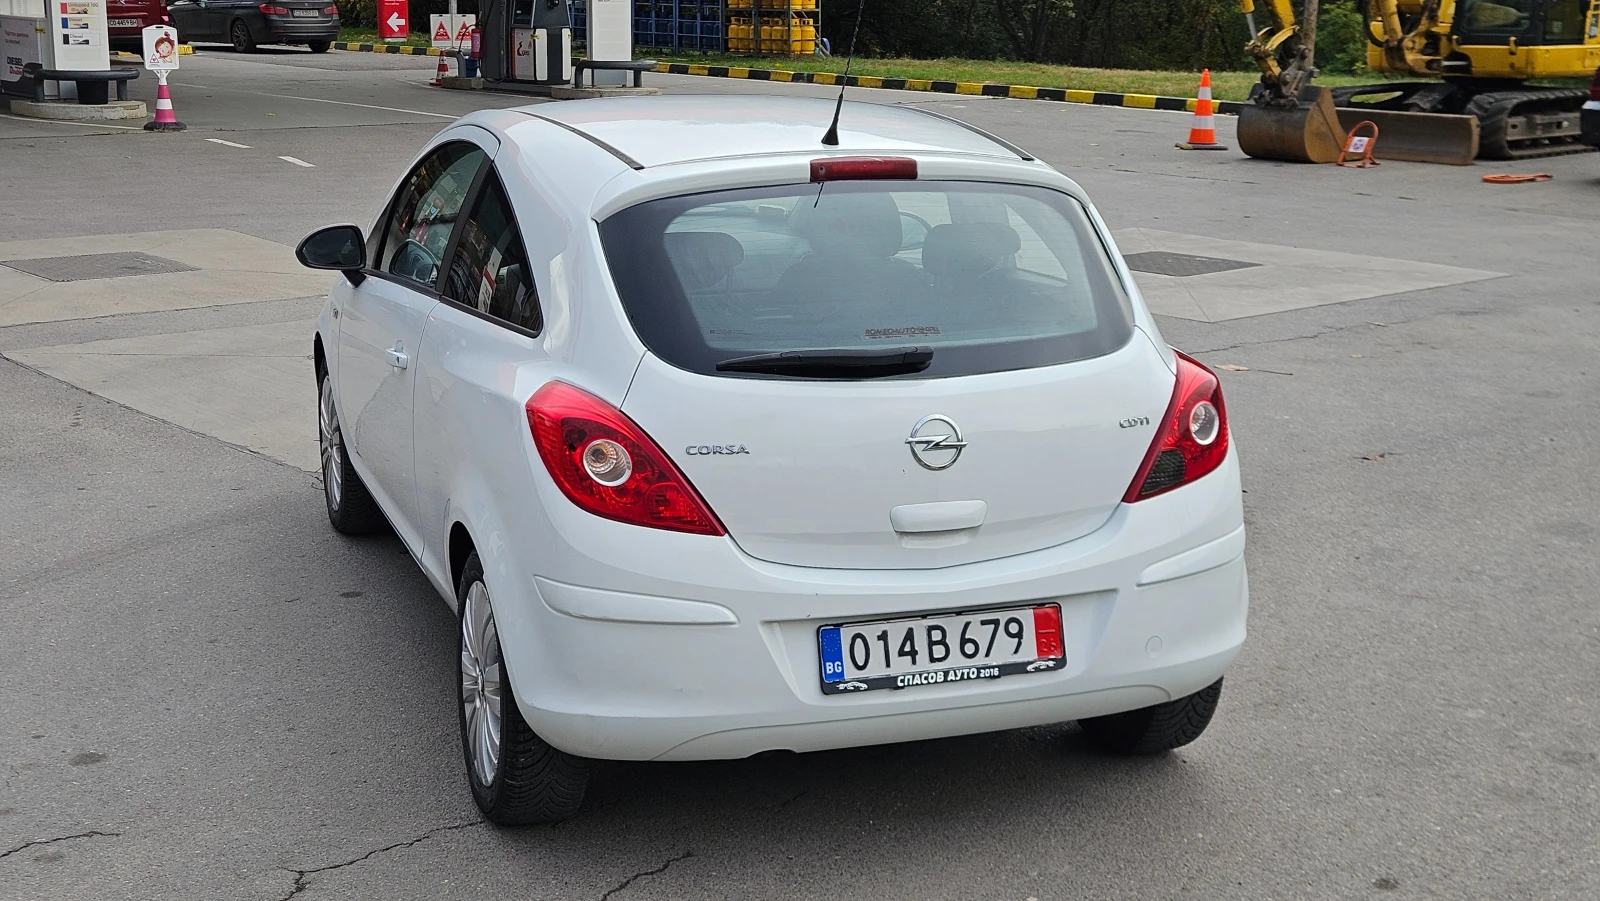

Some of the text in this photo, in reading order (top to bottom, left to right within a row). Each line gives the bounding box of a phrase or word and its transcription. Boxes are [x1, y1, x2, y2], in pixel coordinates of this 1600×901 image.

[685, 444, 751, 455] CORSA
[825, 661, 843, 674] BG
[897, 667, 999, 687] СПАСОВ АУТО 2016
